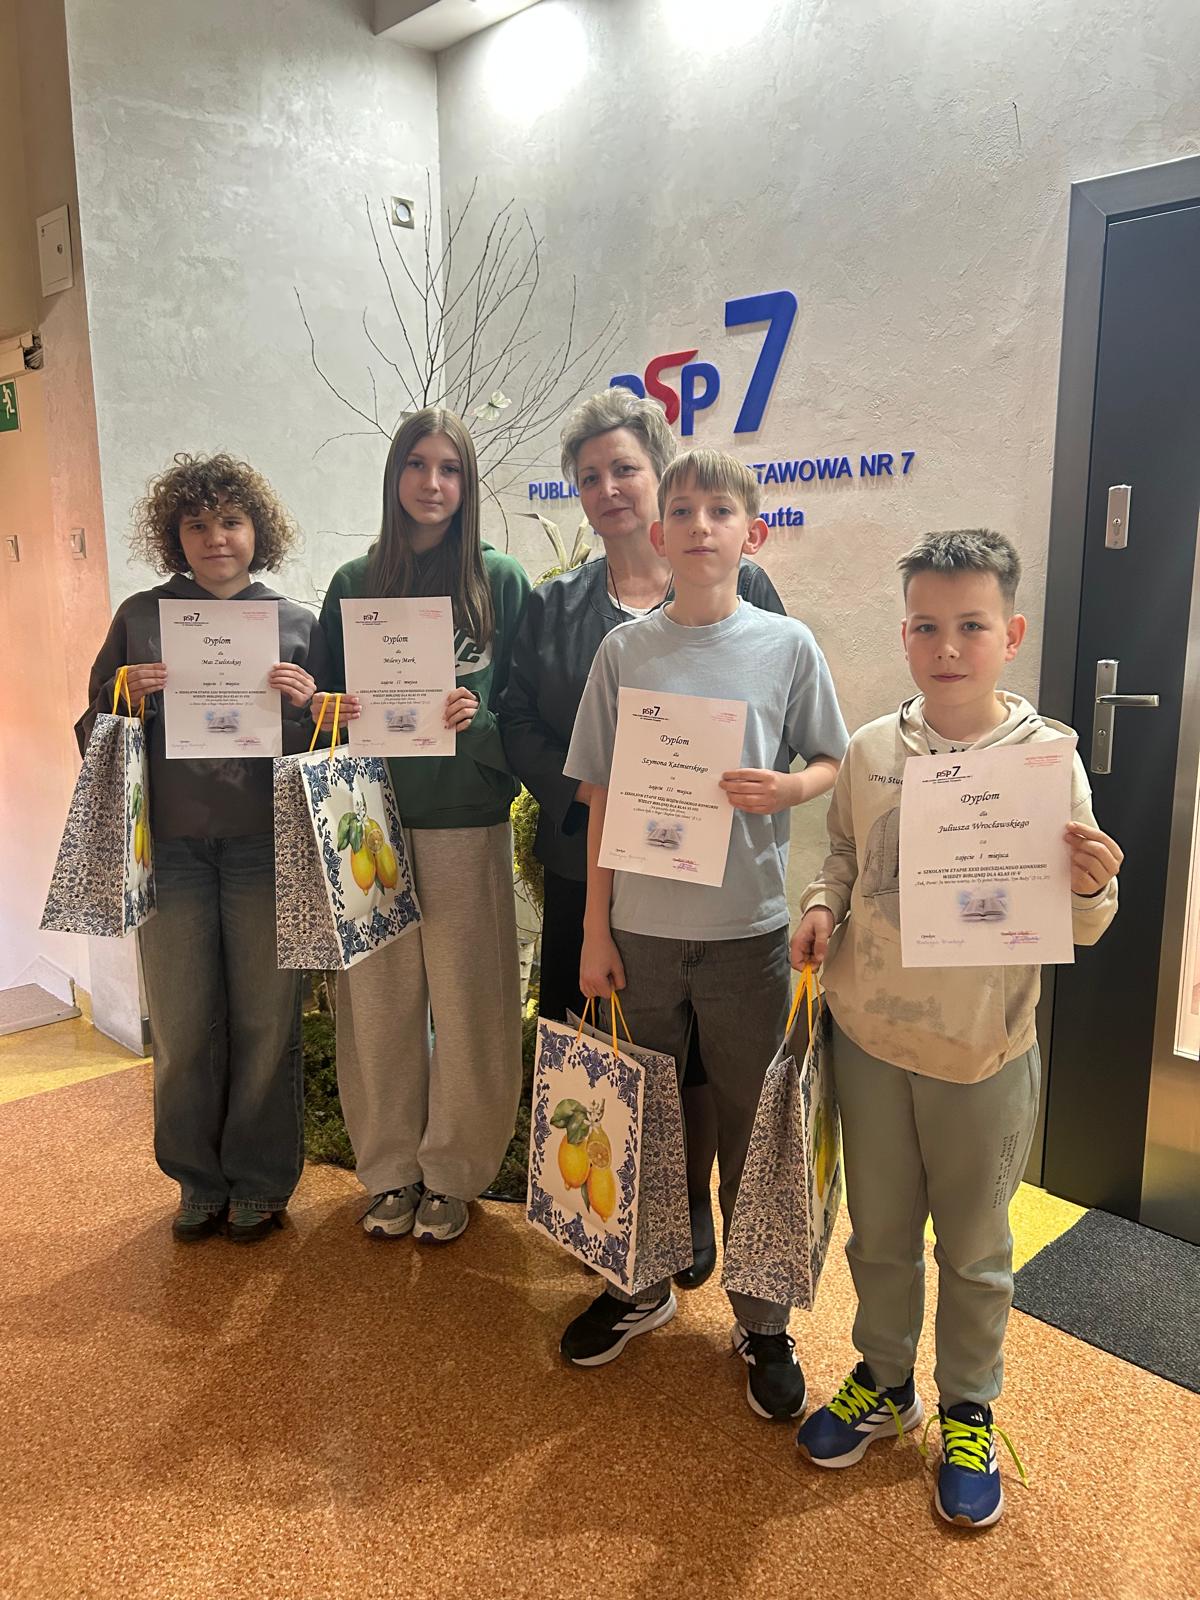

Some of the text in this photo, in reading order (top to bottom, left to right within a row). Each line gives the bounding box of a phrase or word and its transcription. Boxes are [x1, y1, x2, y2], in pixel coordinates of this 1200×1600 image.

[724, 289, 798, 434] 7
[746, 456, 852, 485] TAWOWA
[860, 453, 893, 477] NR
[901, 451, 916, 474] 7
[760, 506, 804, 528] utta
[203, 636, 231, 647] Dyplom
[383, 634, 409, 645] Dyplom
[660, 734, 690, 746] Dyplom
[960, 790, 1000, 806] Dyplom
[937, 818, 1030, 834] Juliusza Wrocławskiego
